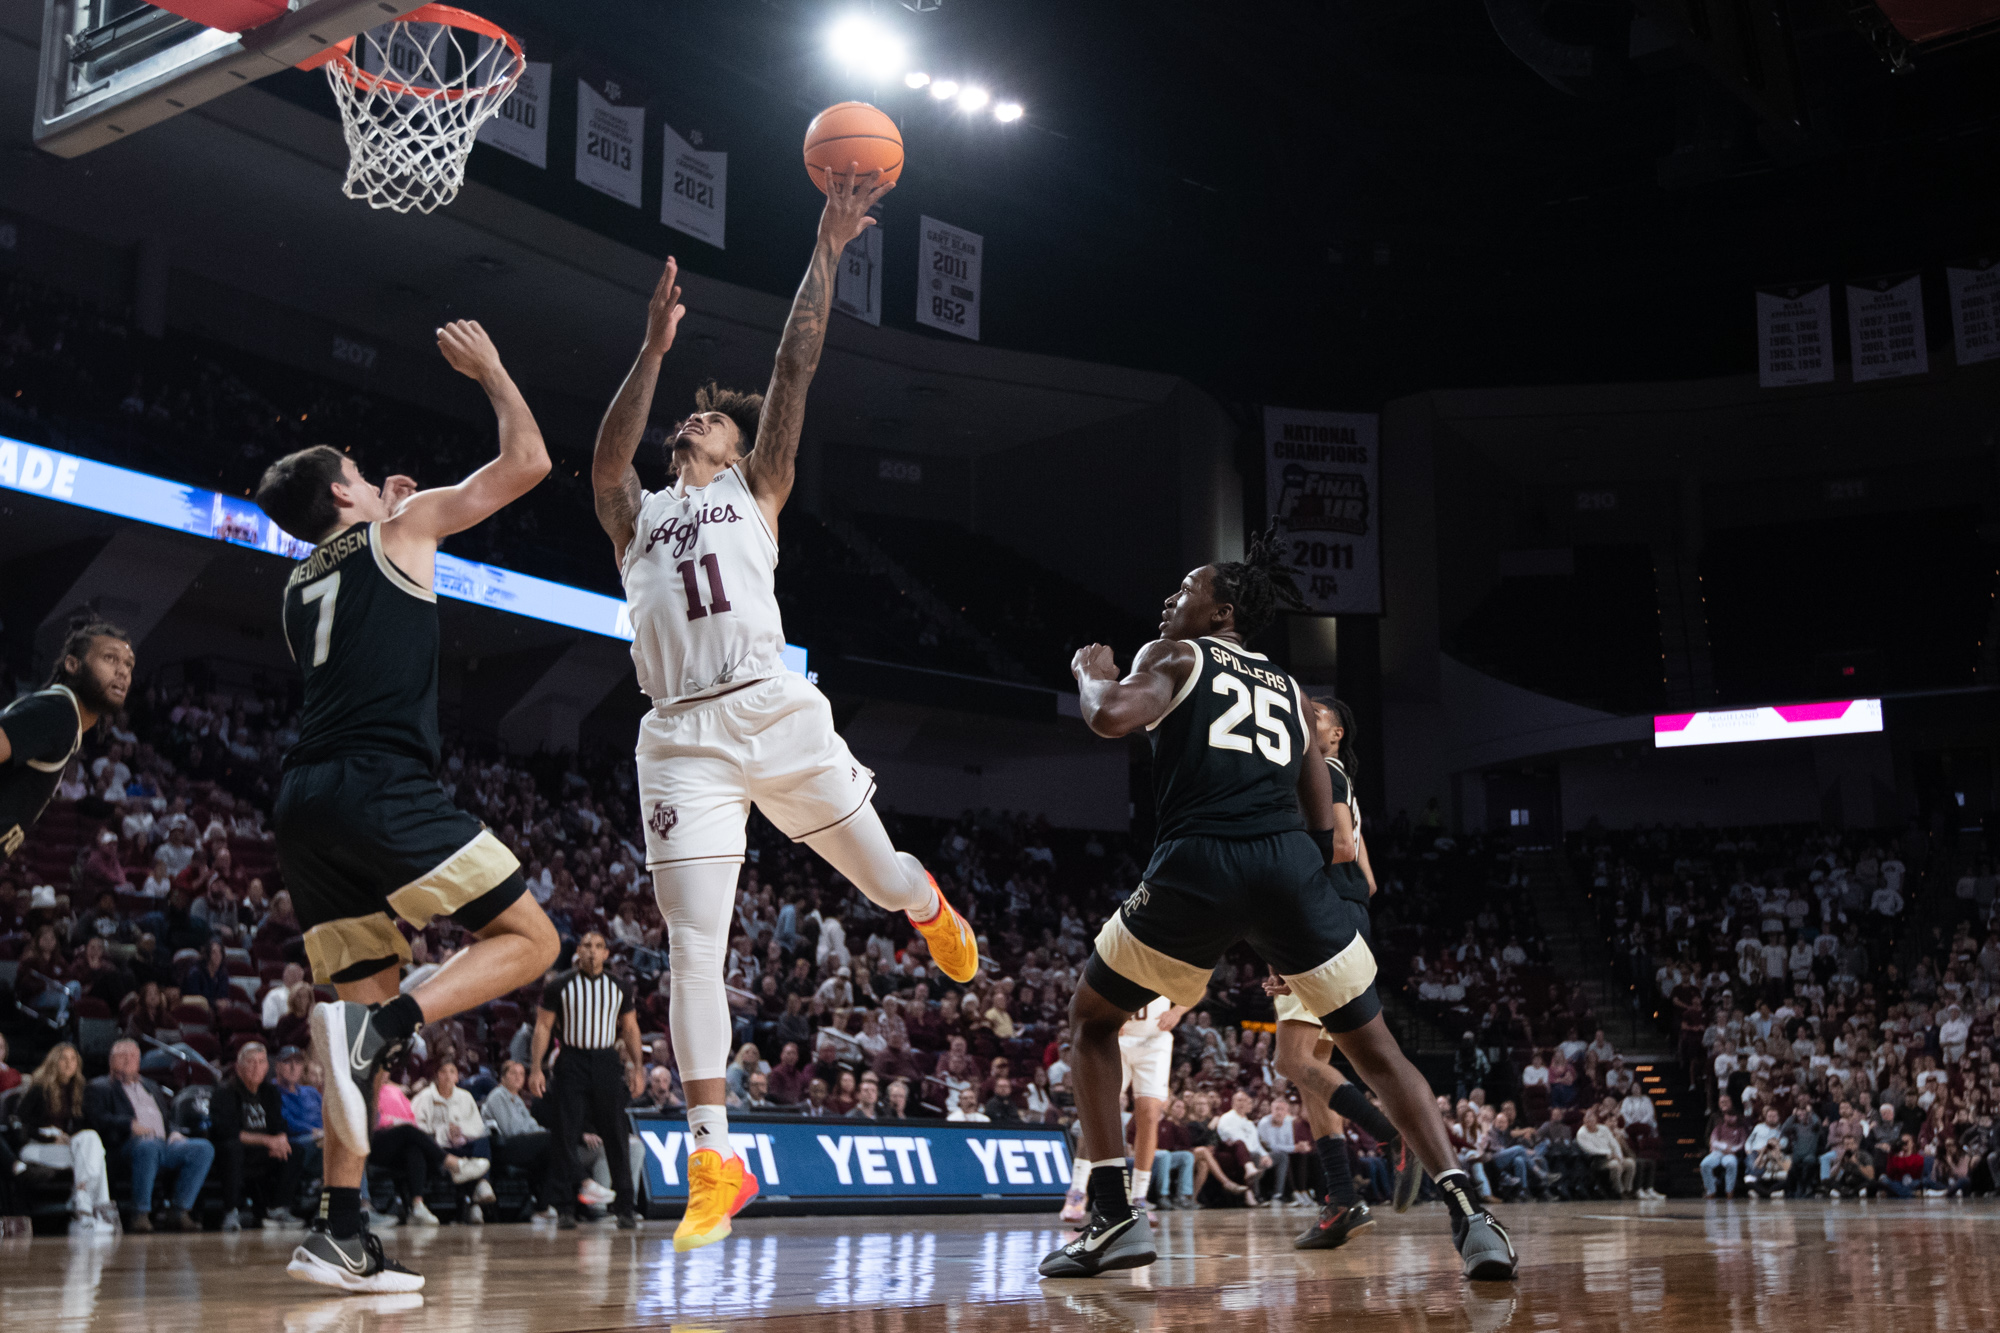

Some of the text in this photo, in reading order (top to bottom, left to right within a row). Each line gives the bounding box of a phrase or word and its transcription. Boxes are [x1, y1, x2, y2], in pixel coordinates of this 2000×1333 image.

[587, 131, 631, 171] 2013
[674, 170, 714, 209] 2021
[933, 251, 967, 280] 2011
[932, 295, 966, 324] 852
[332, 335, 377, 369] 207
[1284, 424, 1358, 445] NATIONAL
[1273, 442, 1368, 464] CHAMPIONS
[878, 459, 922, 482] 209
[1304, 473, 1363, 498] FINAL
[1577, 492, 1616, 511] 210
[1293, 540, 1354, 570] 2011
[676, 553, 731, 622] 11
[301, 570, 341, 668] 7
[1209, 646, 1288, 692] SPILLERS
[1208, 671, 1291, 767] 25
[640, 1131, 1072, 1185] YTI YETI YETI
